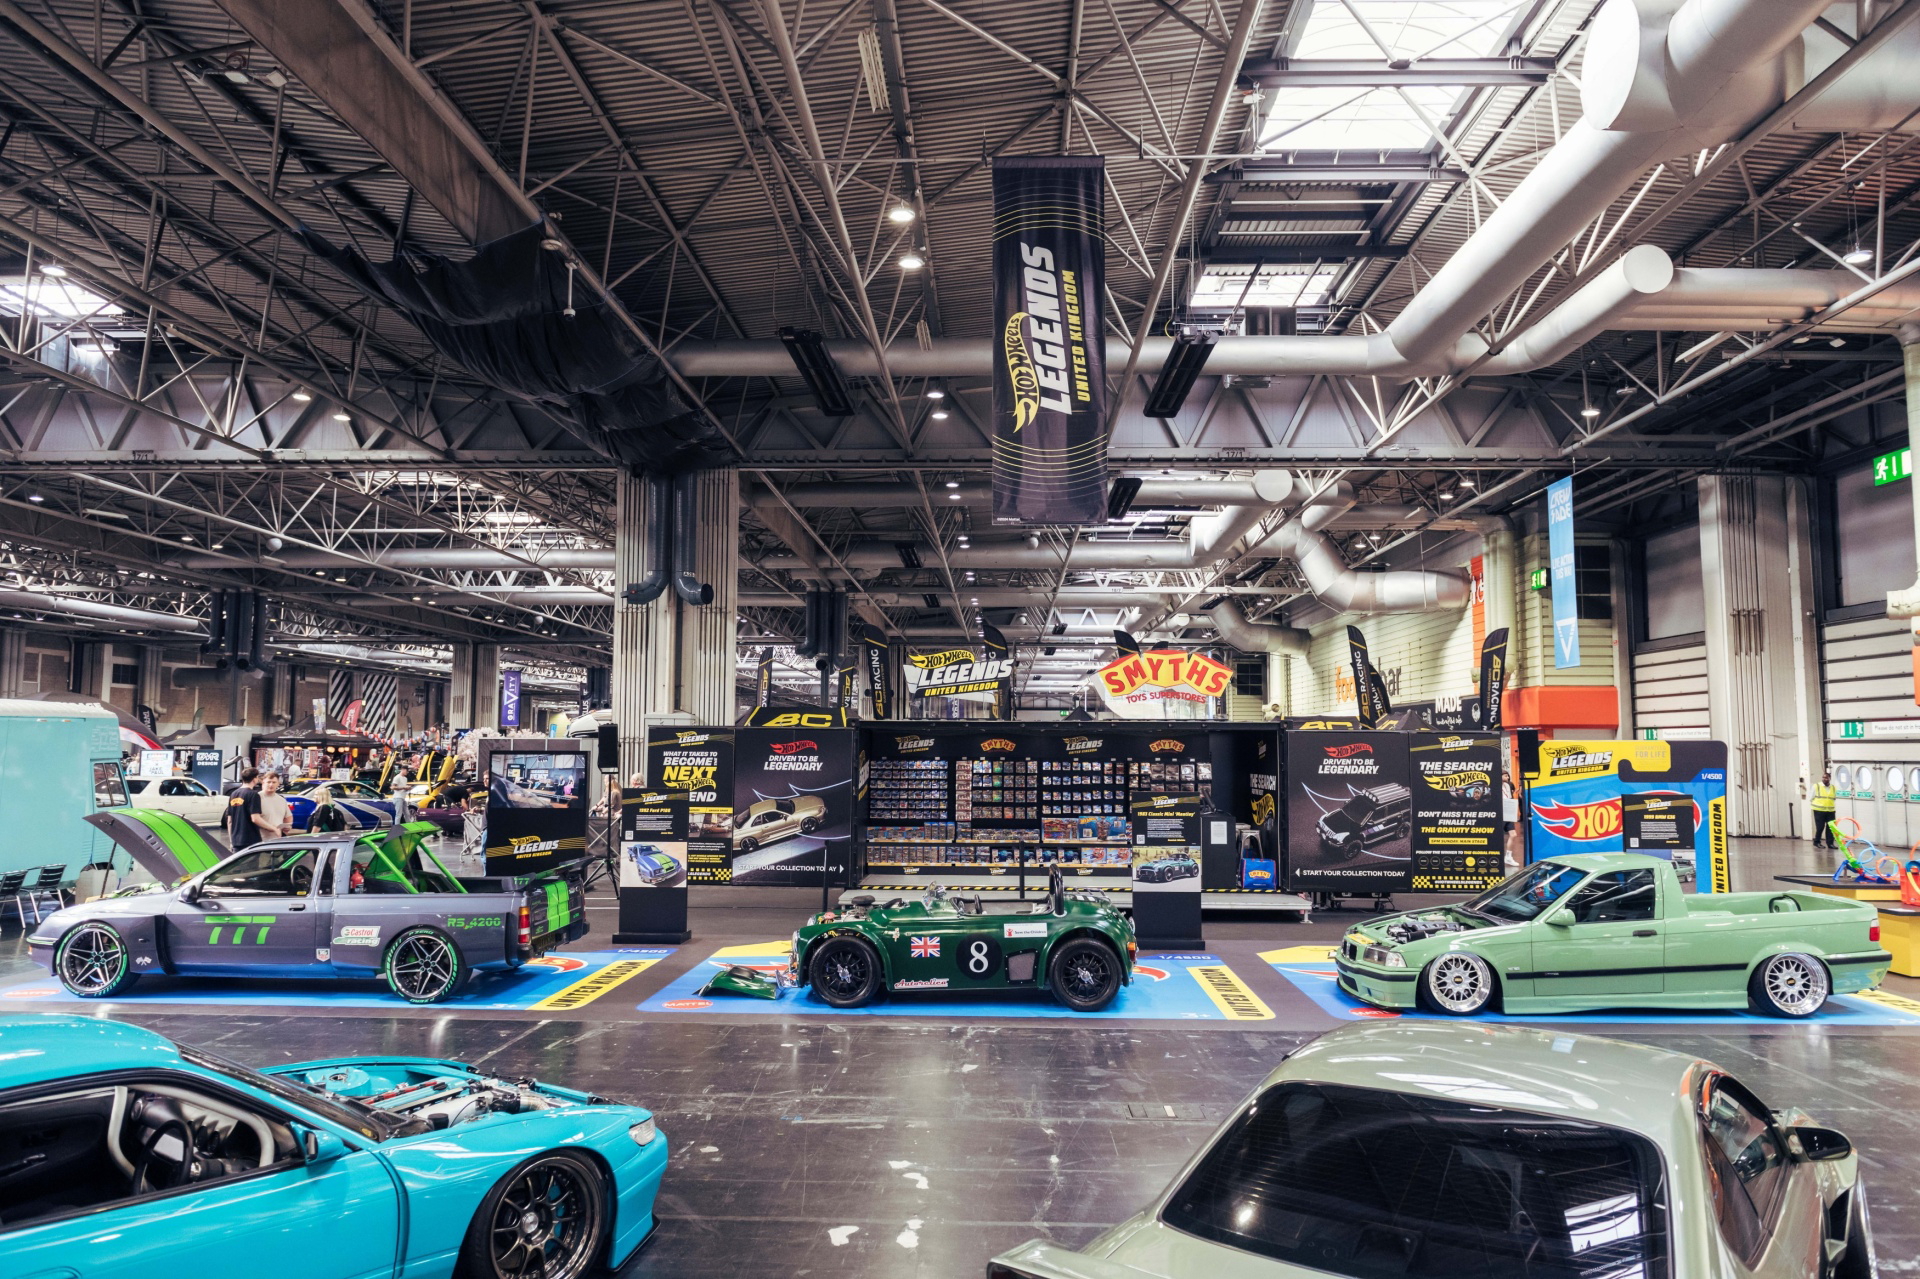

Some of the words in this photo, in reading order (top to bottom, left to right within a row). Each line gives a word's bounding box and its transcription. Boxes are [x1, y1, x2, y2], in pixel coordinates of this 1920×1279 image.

[1062, 269, 1083, 342] KINGDOM
[1020, 241, 1072, 415] LEGENDS
[1071, 346, 1091, 402] UNITED
[870, 648, 882, 690] RACING
[925, 655, 944, 668] HOT
[918, 659, 1014, 686] LEGENDS
[1105, 658, 1228, 693] SMYTHS
[1354, 650, 1366, 693] RACING
[924, 686, 956, 697] UNITED
[958, 681, 999, 693] KINGDOM
[1335, 666, 1356, 704] foo
[503, 676, 519, 720] GRAVITY
[1126, 693, 1147, 704] TOYS
[1149, 691, 1206, 704] SUPERSTORES
[1435, 696, 1462, 713] MADE
[1489, 681, 1499, 723] RACING
[762, 713, 833, 728] BC
[781, 742, 795, 754] HOT
[898, 738, 935, 750] LEGENDS
[982, 739, 1014, 752] SMYTHS
[1066, 740, 1104, 750] LEGENDS
[1150, 740, 1184, 752] SMYTHS
[1337, 746, 1349, 756] HOT
[1442, 739, 1474, 748] LEGENDS
[663, 757, 712, 766] BECOME
[764, 762, 824, 771] LEGENDARY
[1420, 762, 1442, 771] THE
[1443, 762, 1493, 771] SEARCH
[1552, 751, 1613, 769] LEGENDS
[662, 766, 718, 780] NEXT
[1318, 765, 1379, 774] LEGENDARY
[1441, 777, 1458, 789] HOT
[1569, 802, 1620, 838] HOT
[1713, 804, 1723, 854] KINGDOM
[513, 840, 560, 854] LEGENDS
[204, 916, 276, 944] 777
[448, 918, 465, 927] RS
[470, 918, 501, 926] 4200
[346, 937, 378, 946] racing
[969, 941, 988, 973] 8
[546, 985, 601, 1008] UNITED
[596, 962, 646, 984] KINGDOM
[1198, 968, 1242, 992] KINGDOM
[1220, 994, 1265, 1017] UNITED
